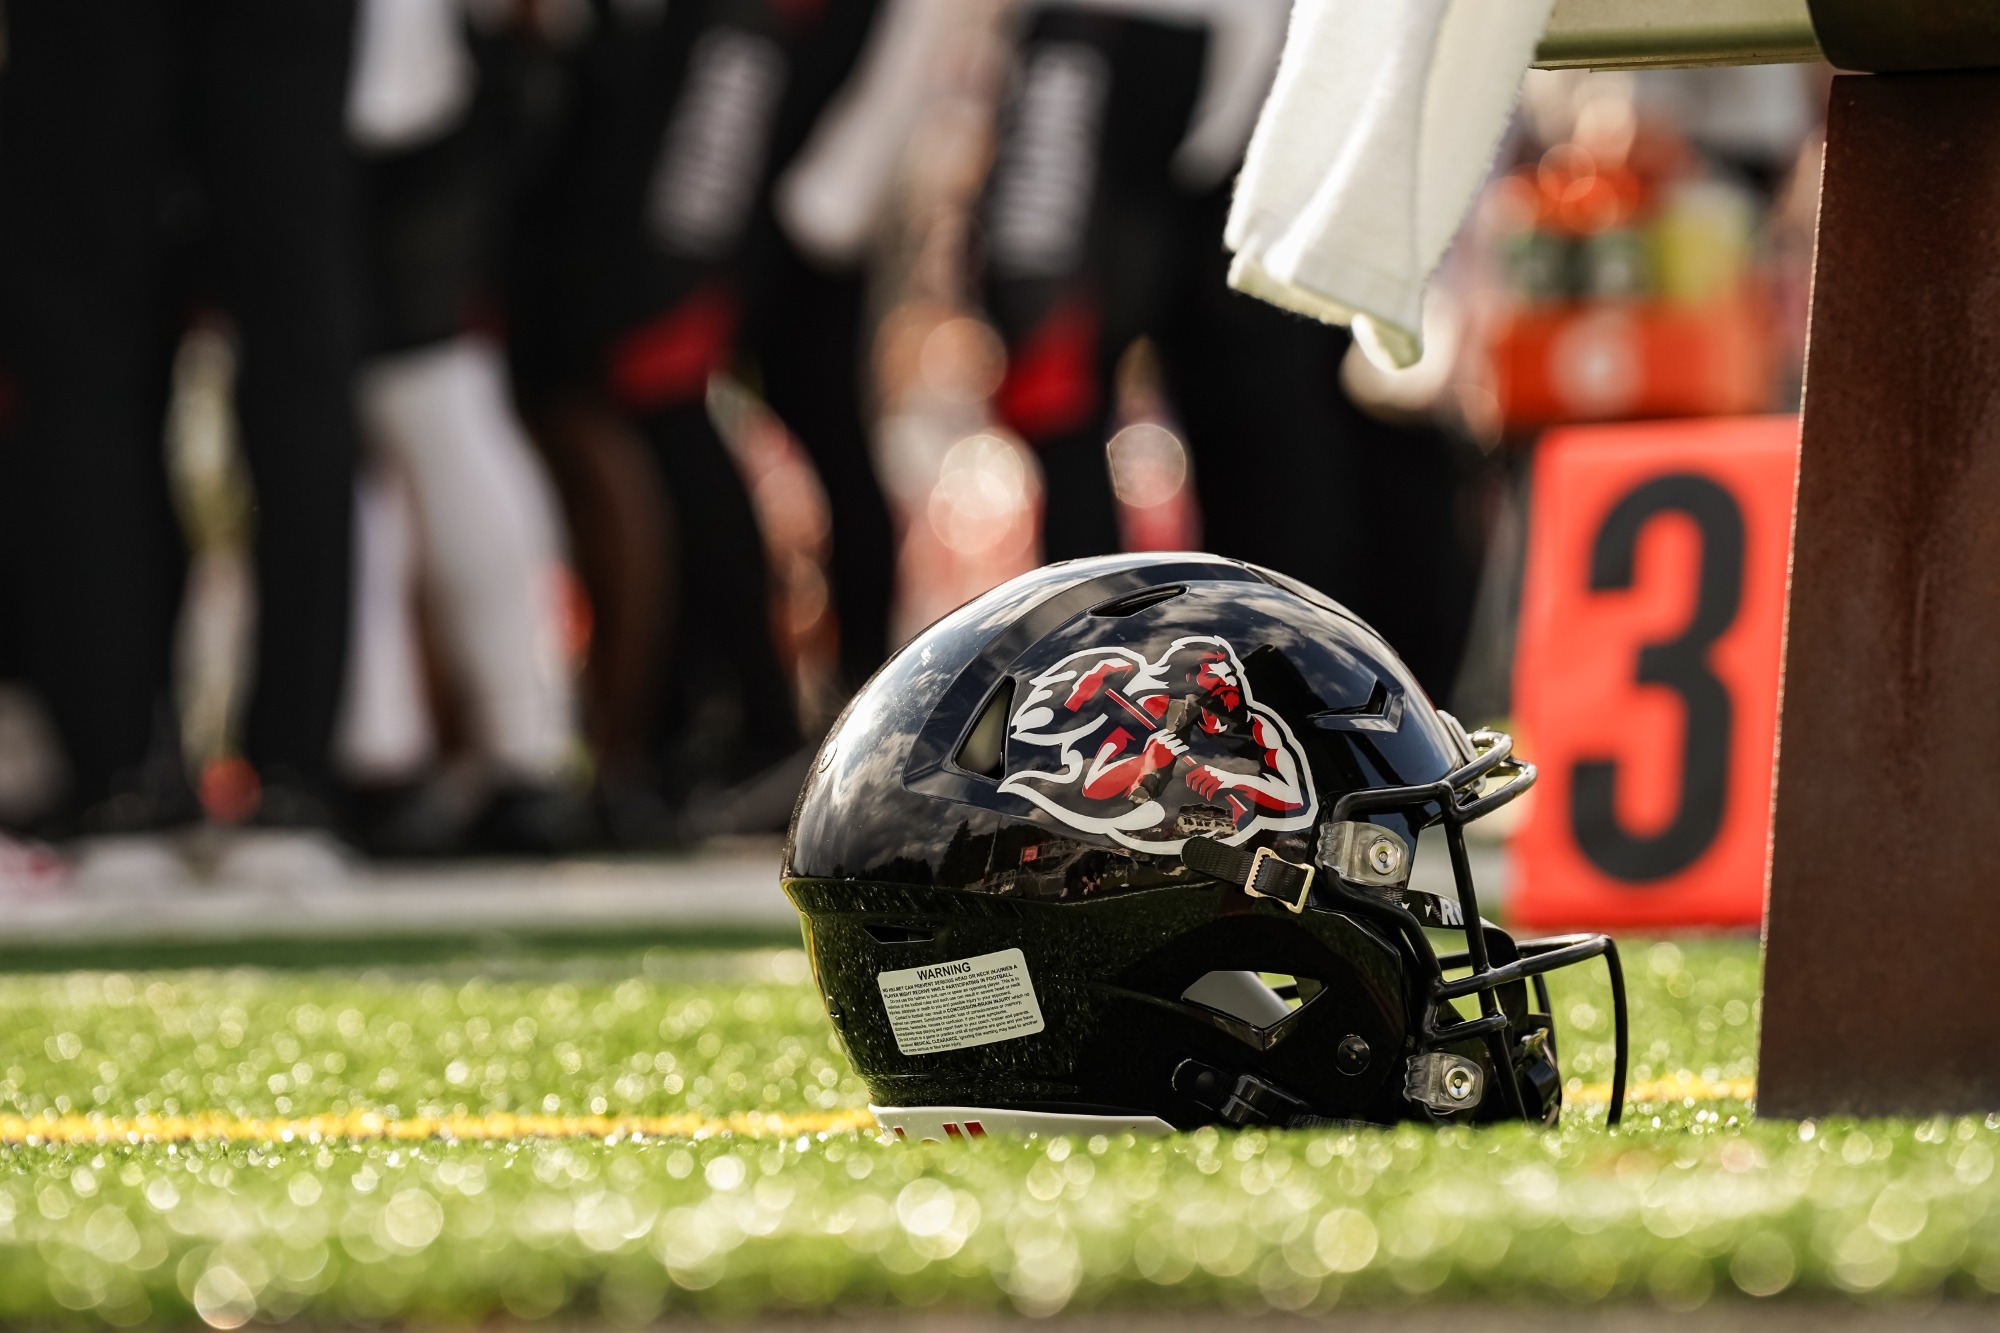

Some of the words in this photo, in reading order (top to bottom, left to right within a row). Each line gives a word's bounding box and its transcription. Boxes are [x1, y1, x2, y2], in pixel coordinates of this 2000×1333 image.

[1570, 473, 1745, 885] 3
[917, 962, 971, 980] WARNING
[990, 966, 1013, 975] INJURIES
[946, 979, 979, 990] PARTICIPATING
